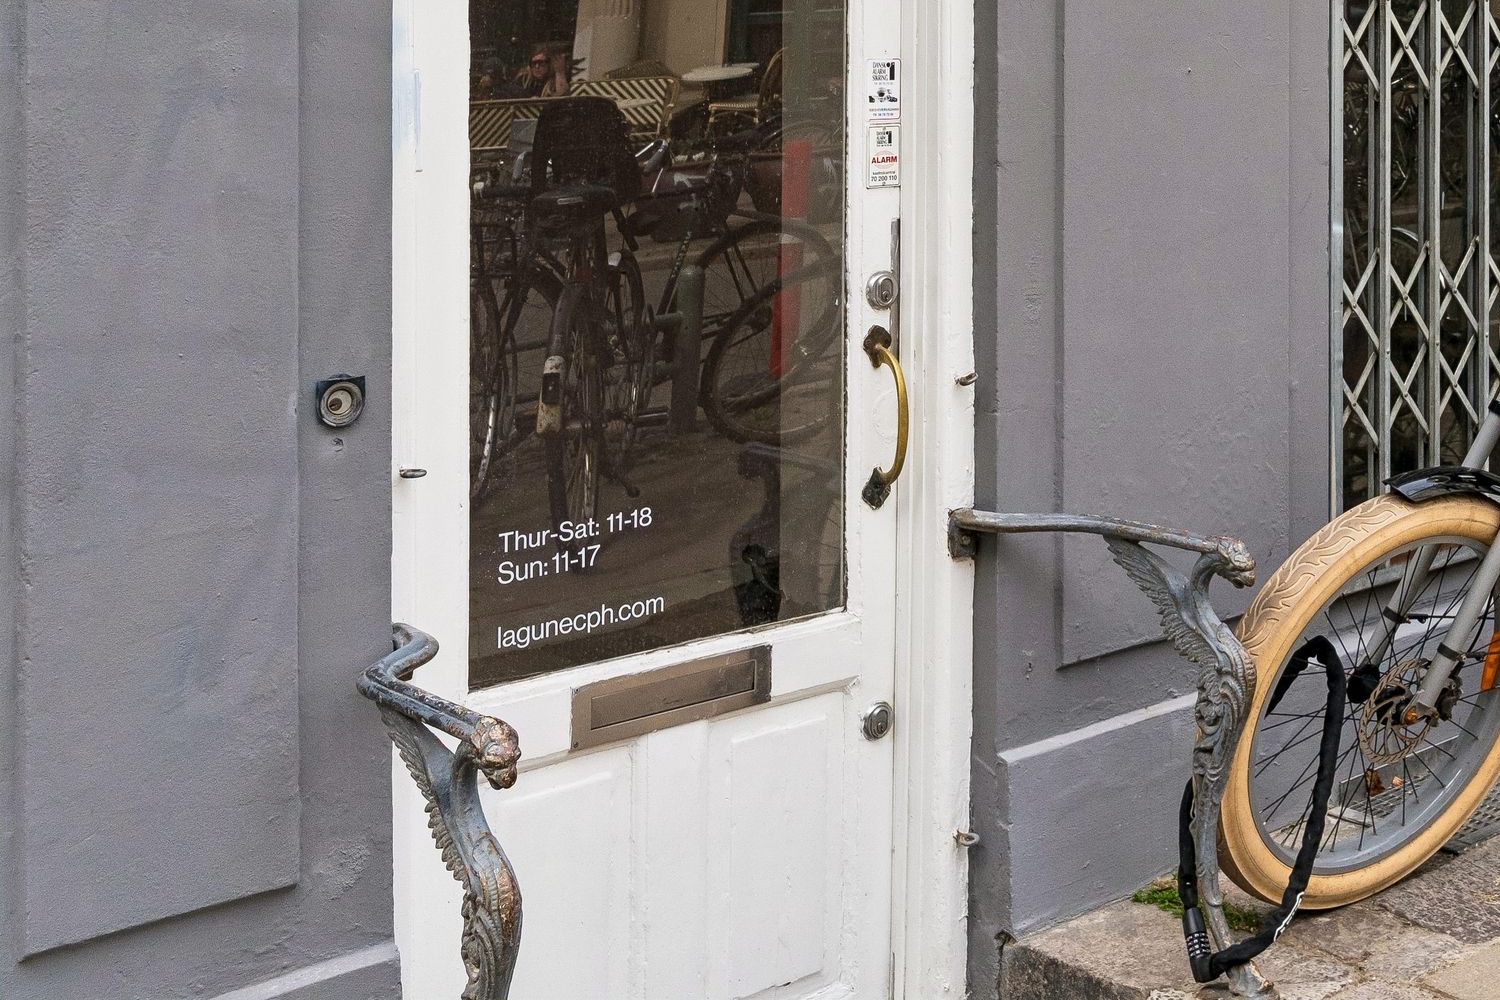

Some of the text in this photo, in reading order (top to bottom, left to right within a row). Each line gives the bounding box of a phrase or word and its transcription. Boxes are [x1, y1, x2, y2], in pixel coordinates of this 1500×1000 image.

[871, 155, 898, 164] ALARM
[498, 507, 653, 553] Thur-Sat: 11-18
[497, 544, 601, 585] Sun: 11-17
[497, 596, 665, 649] lagunecph.com
